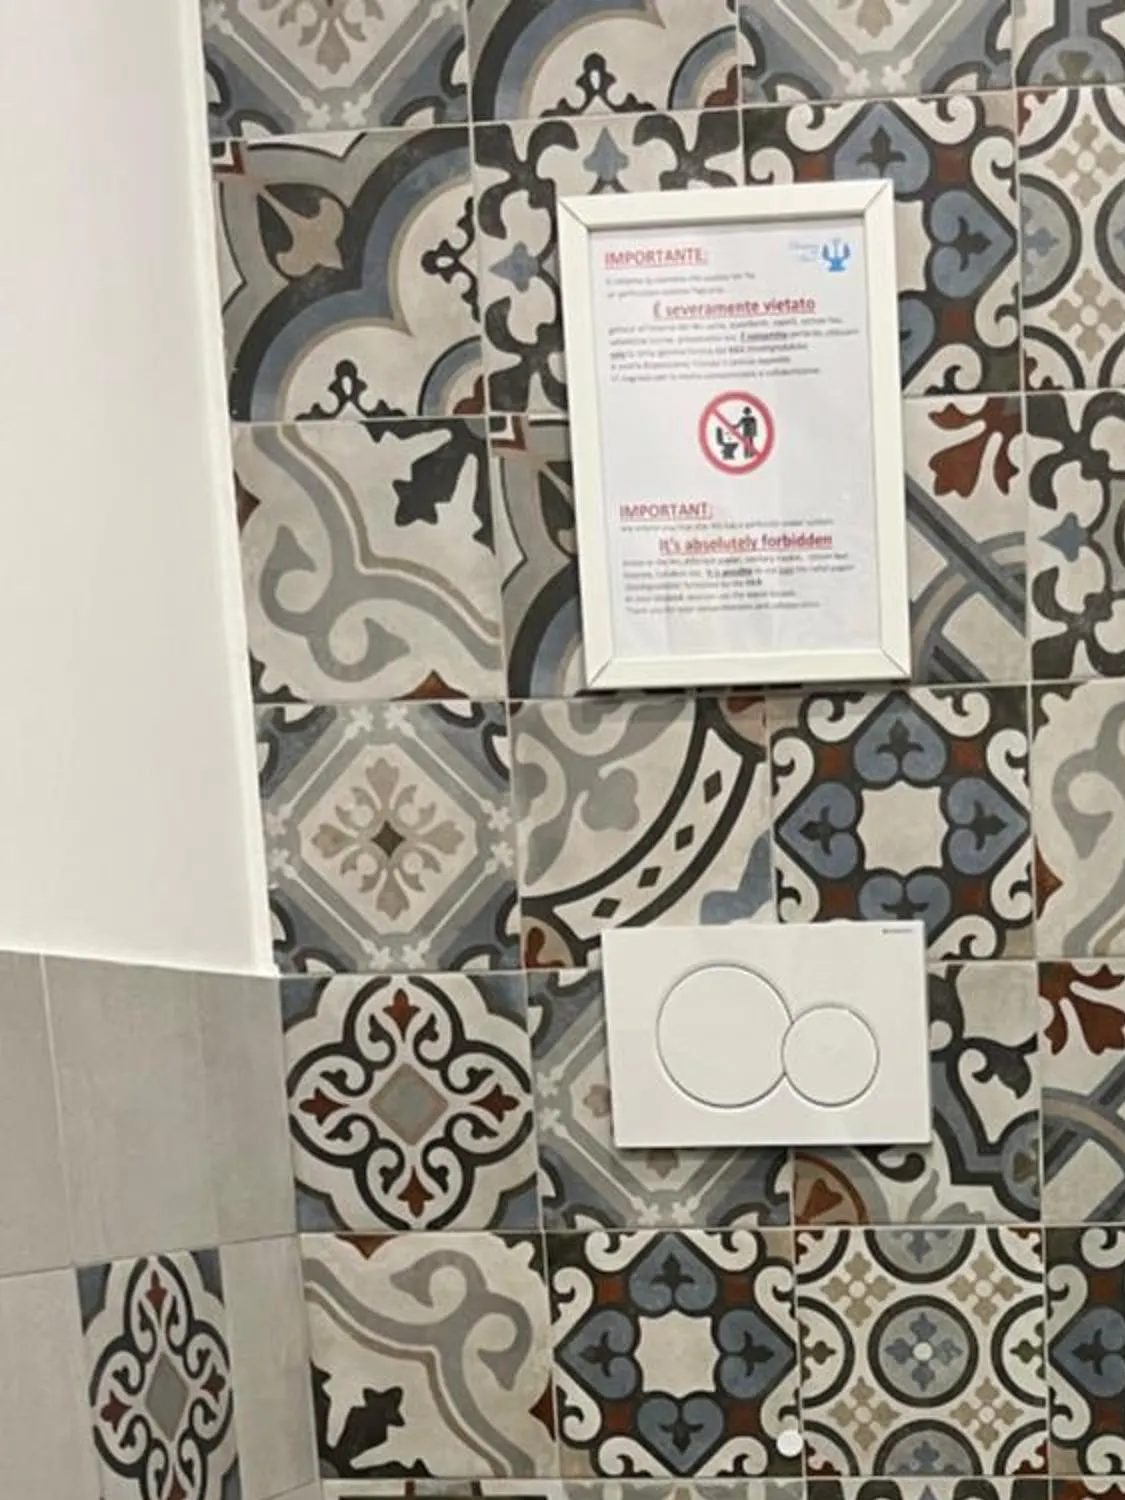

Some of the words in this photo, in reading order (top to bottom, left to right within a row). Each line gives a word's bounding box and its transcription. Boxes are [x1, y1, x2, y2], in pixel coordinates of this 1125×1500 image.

[667, 302, 760, 318] severamente
[763, 298, 817, 314] vietato
[659, 538, 682, 555] It's
[686, 534, 759, 554] absolutely
[762, 530, 833, 549] forbidden
